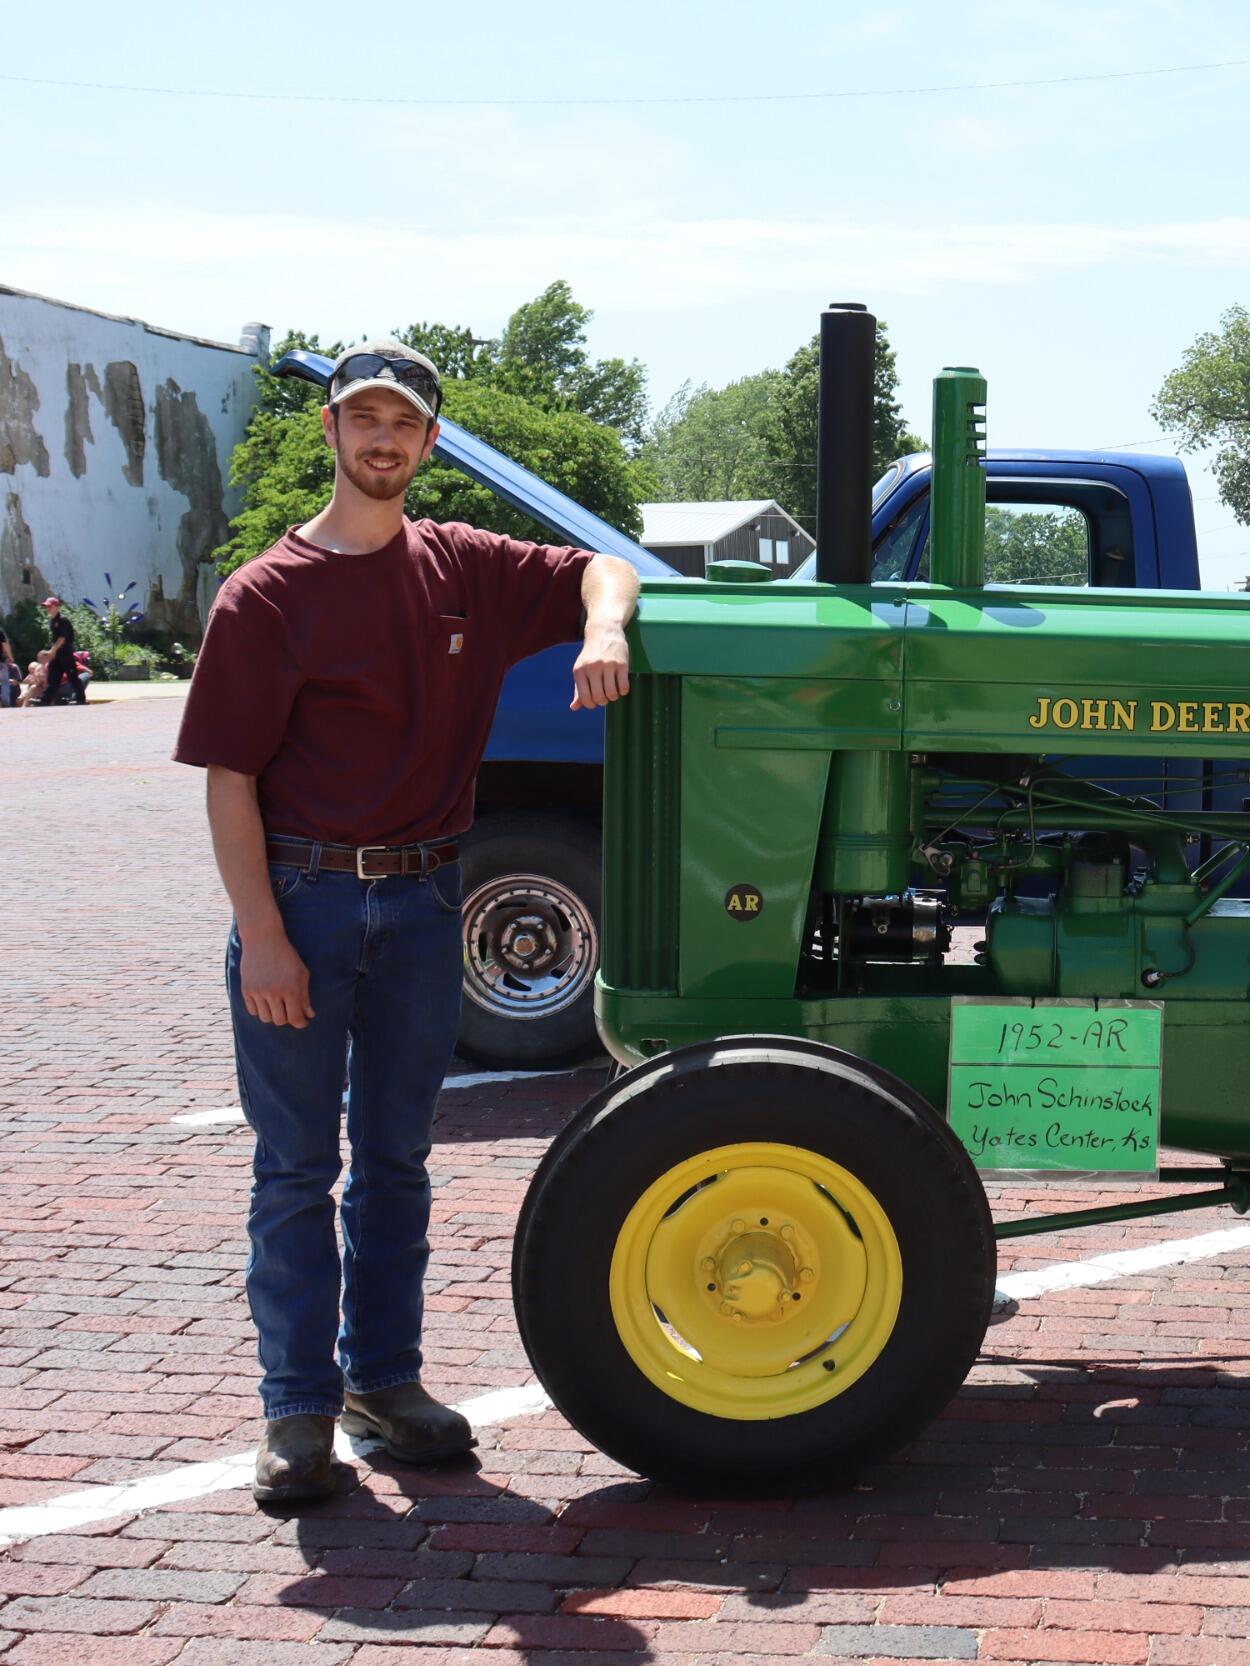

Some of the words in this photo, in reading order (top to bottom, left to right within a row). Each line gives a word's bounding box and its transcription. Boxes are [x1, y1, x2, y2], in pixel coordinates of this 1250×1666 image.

[1028, 697, 1138, 731] JOHN
[727, 894, 759, 911] AR
[997, 1018, 1129, 1054] 1952-AR
[967, 1082, 1032, 1109] John
[1037, 1077, 1153, 1117] Schinstock
[969, 1124, 1037, 1156] Yates
[1045, 1122, 1116, 1152] Center,
